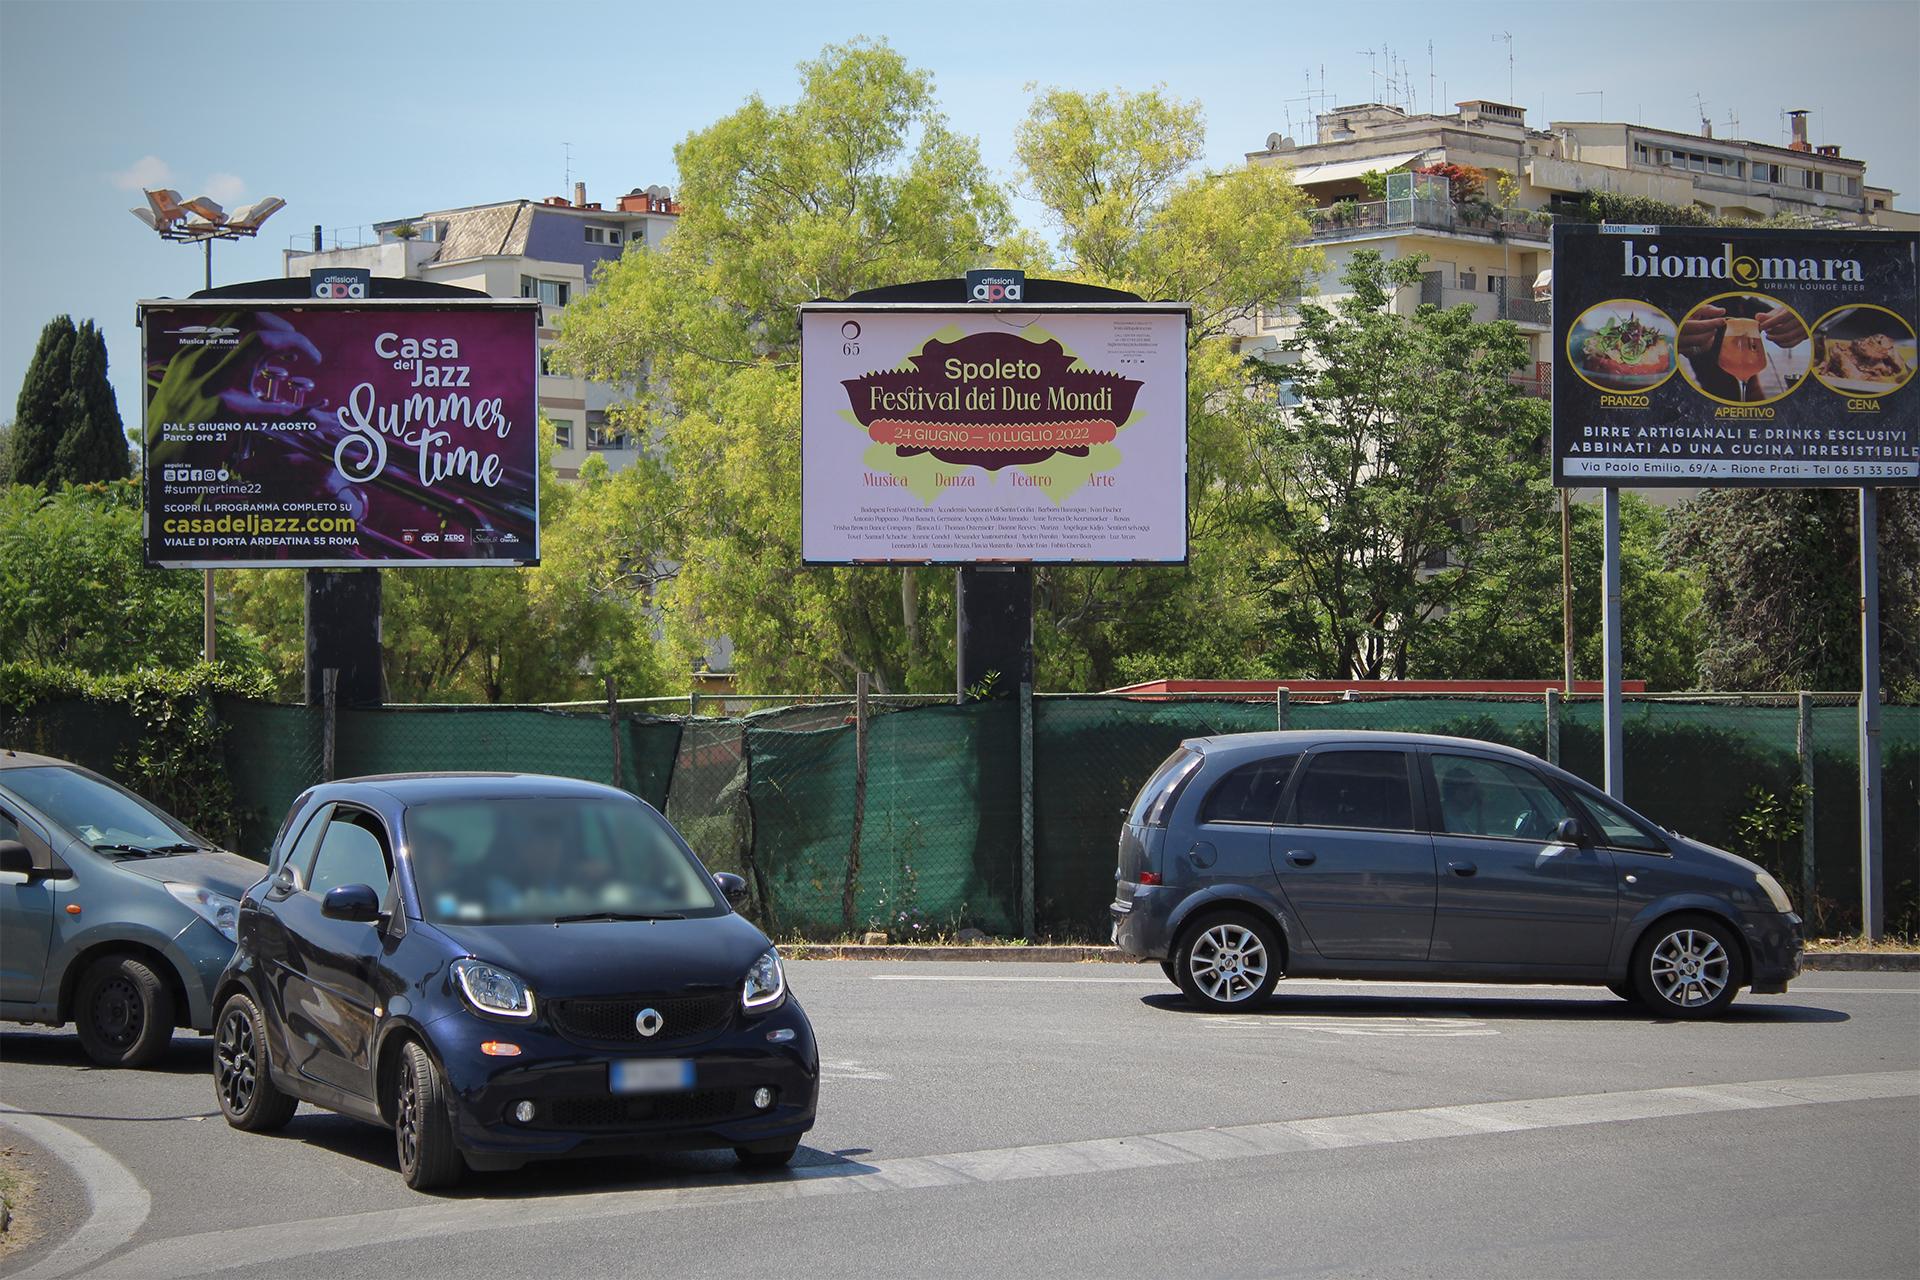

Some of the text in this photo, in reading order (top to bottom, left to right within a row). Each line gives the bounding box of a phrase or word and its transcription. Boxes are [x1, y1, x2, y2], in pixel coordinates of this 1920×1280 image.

[1603, 225, 1626, 233] STUNT
[1764, 282, 1796, 290] URBAN
[1800, 283, 1838, 291] LOUNGE
[973, 285, 1021, 303] apa
[374, 332, 459, 359] Casa
[842, 342, 860, 356] 65
[393, 359, 414, 370] del
[945, 358, 1041, 384] Spoleto
[411, 359, 471, 387] Jazz
[870, 386, 1113, 411] Festival dei Due Mondi
[1600, 396, 1649, 407] PRANZO
[1847, 399, 1881, 410] CENA
[1714, 407, 1775, 418] APERITIVO
[163, 422, 317, 432] DAL 5 GIUGNO AL 7 AGOSTO
[334, 382, 512, 483] Summer
[1584, 426, 1906, 441] BIRRE ARTIGIANALI E DRINKS ESCLUSIVI
[163, 433, 227, 442] Parco ore 21
[893, 428, 912, 439] 24
[914, 429, 969, 442] GIUGNO
[988, 431, 1001, 443] 10
[1003, 430, 1053, 443] LUGLIO
[1056, 427, 1090, 441] 2022
[1569, 442, 1919, 457] ABBINATI AD UNA CUCINA IRRESISTIBILE
[1581, 462, 1600, 472] Via
[1605, 462, 1639, 472] Paolo
[1688, 463, 1718, 474] 69/A
[1731, 464, 1766, 474] Rione
[1770, 464, 1800, 474] Prati
[1813, 464, 1830, 474] Tel
[1834, 465, 1849, 475] 06
[1853, 465, 1865, 475] 51
[1869, 466, 1882, 475] 33
[1887, 466, 1908, 476] 505
[862, 472, 1116, 488] Musica Danza Teatro Arte
[164, 483, 262, 495] #summertime22
[164, 503, 352, 513] SCOPRI IL PROGRAMMA COMPLETO SU
[163, 514, 356, 536] casadeljazz.com
[164, 537, 360, 546] VIALE DI PORTA ARDEATINA 55 ROMA
